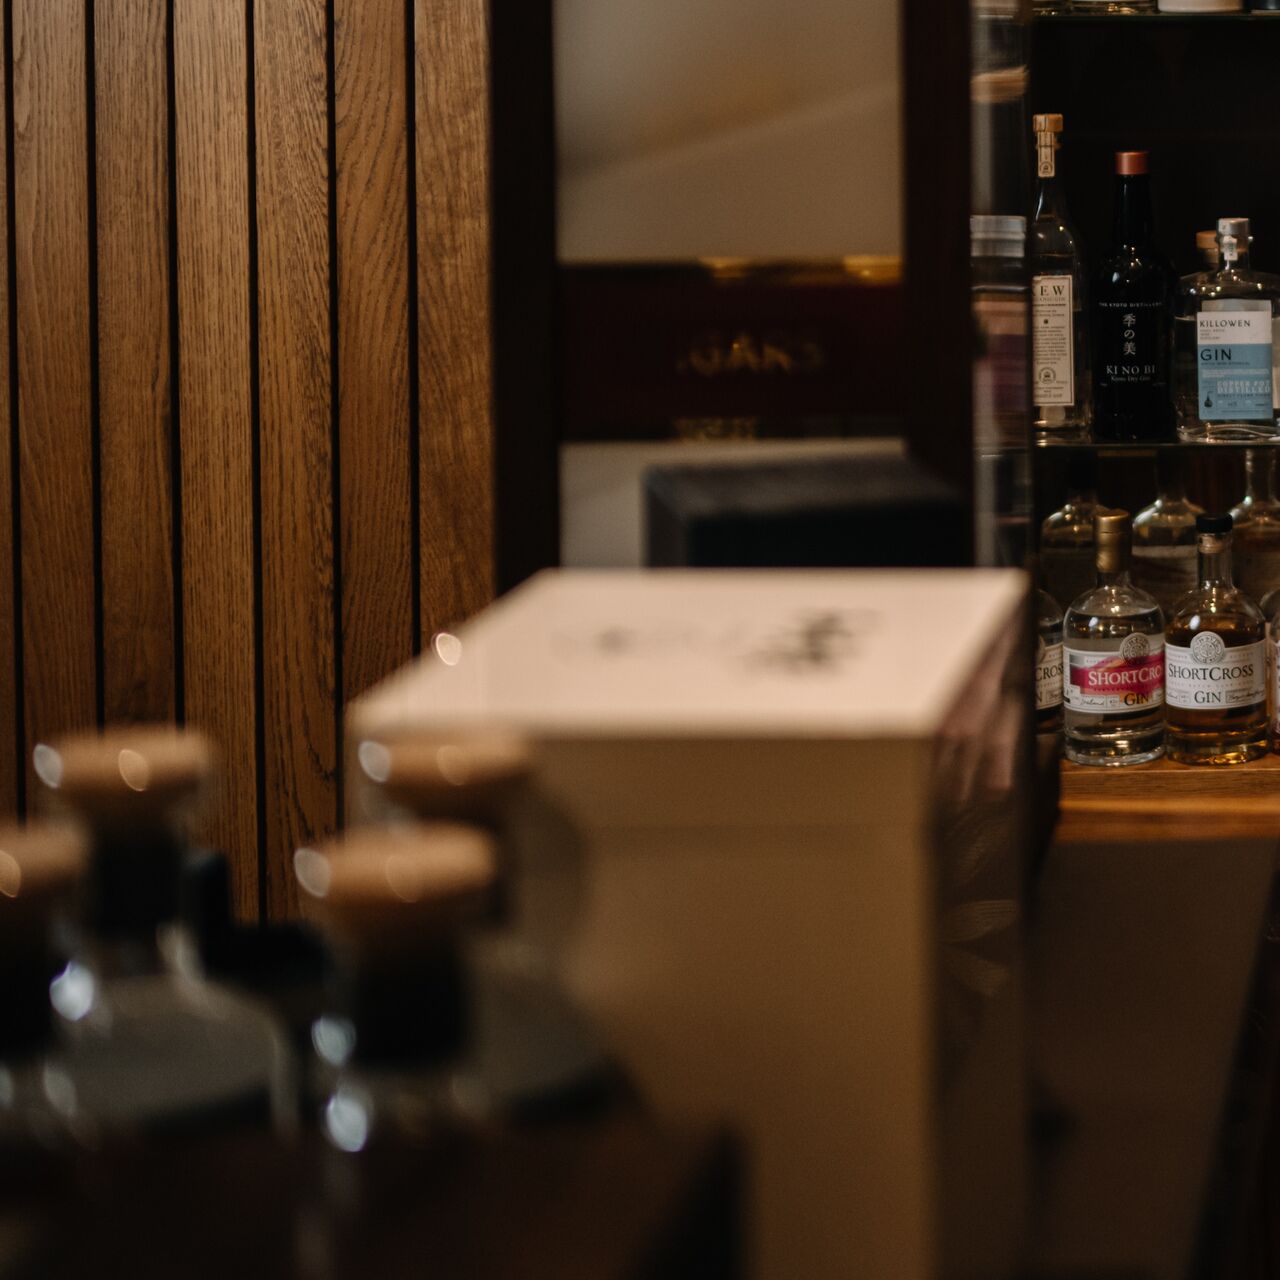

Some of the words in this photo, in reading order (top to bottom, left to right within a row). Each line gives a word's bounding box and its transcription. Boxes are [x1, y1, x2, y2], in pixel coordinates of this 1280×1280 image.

[1199, 319, 1252, 328] KILLOWEN
[1121, 312, 1137, 357] 季の美
[1200, 347, 1232, 362] GIN
[1105, 364, 1119, 376] KI
[1121, 364, 1141, 376] NO
[1143, 363, 1157, 375] BI
[1088, 667, 1164, 686] SHORTCRO
[1168, 661, 1255, 682] SHORTCROSS
[1122, 693, 1150, 707] GIN
[1193, 691, 1222, 706] GIN
